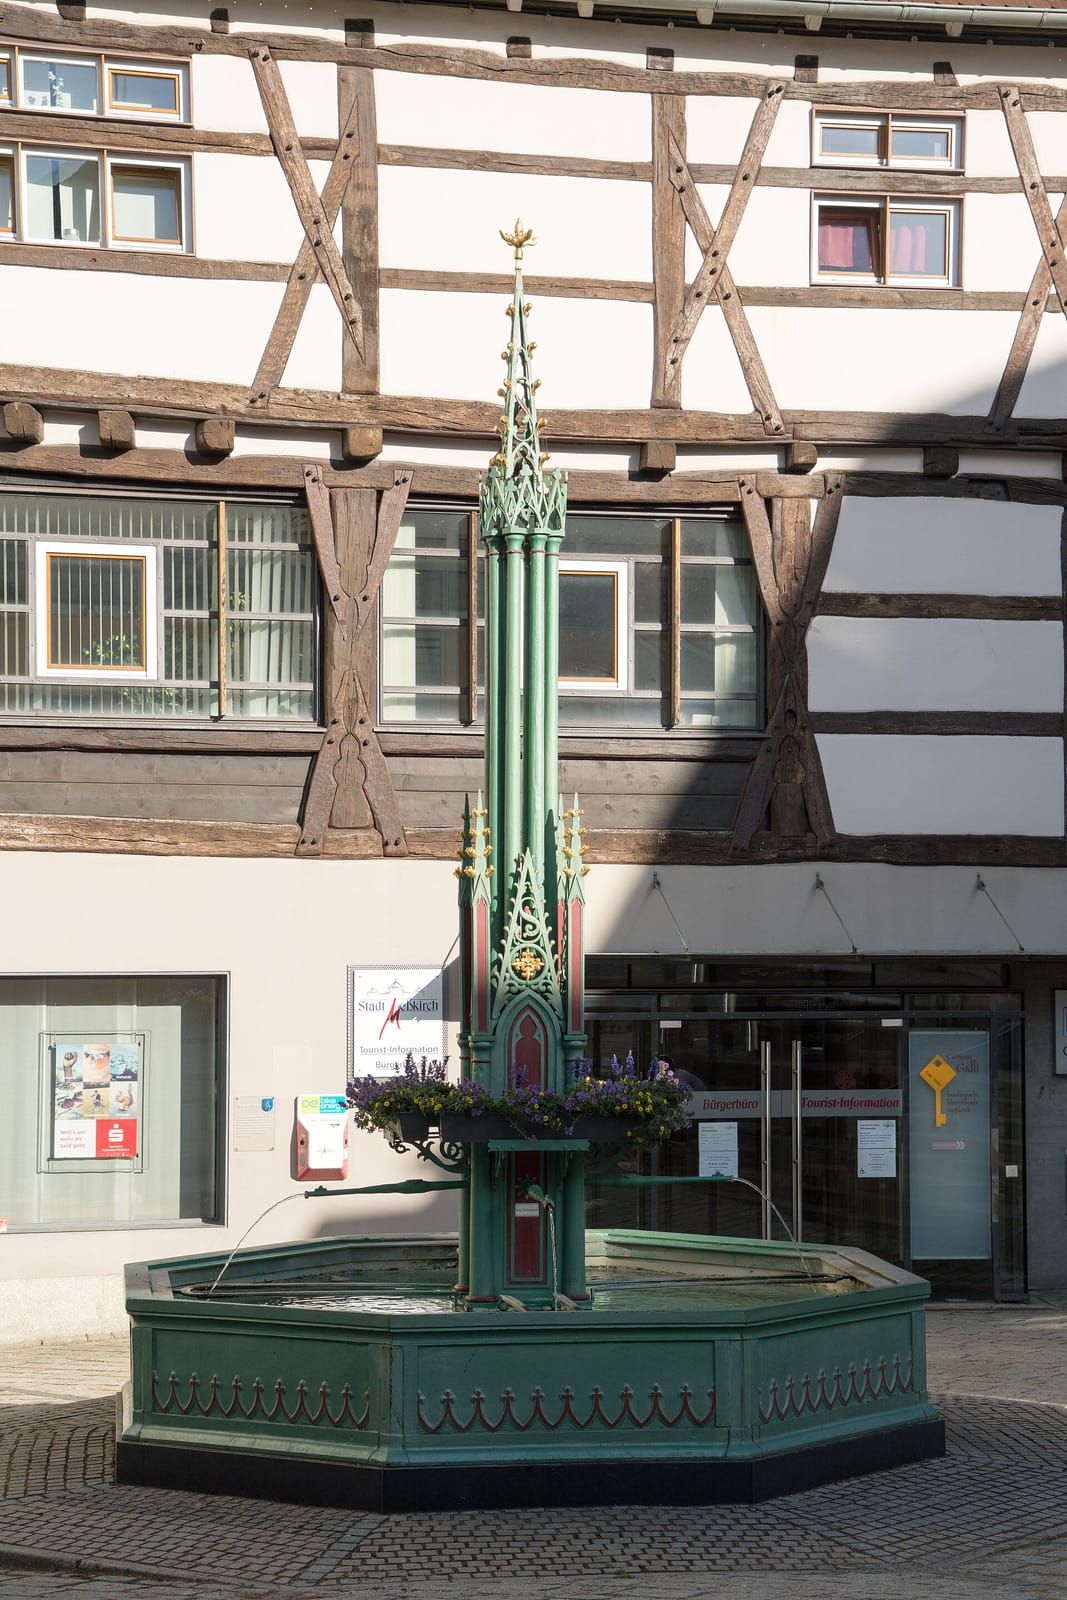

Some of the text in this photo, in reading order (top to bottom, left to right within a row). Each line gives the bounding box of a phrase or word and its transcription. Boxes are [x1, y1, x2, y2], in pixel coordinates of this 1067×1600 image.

[358, 1000, 385, 1012] Stadt
[360, 1046, 439, 1054] Tourist-Information
[703, 1098, 759, 1112] Bürgerbüro
[801, 1097, 900, 1110] Tourist-Information
